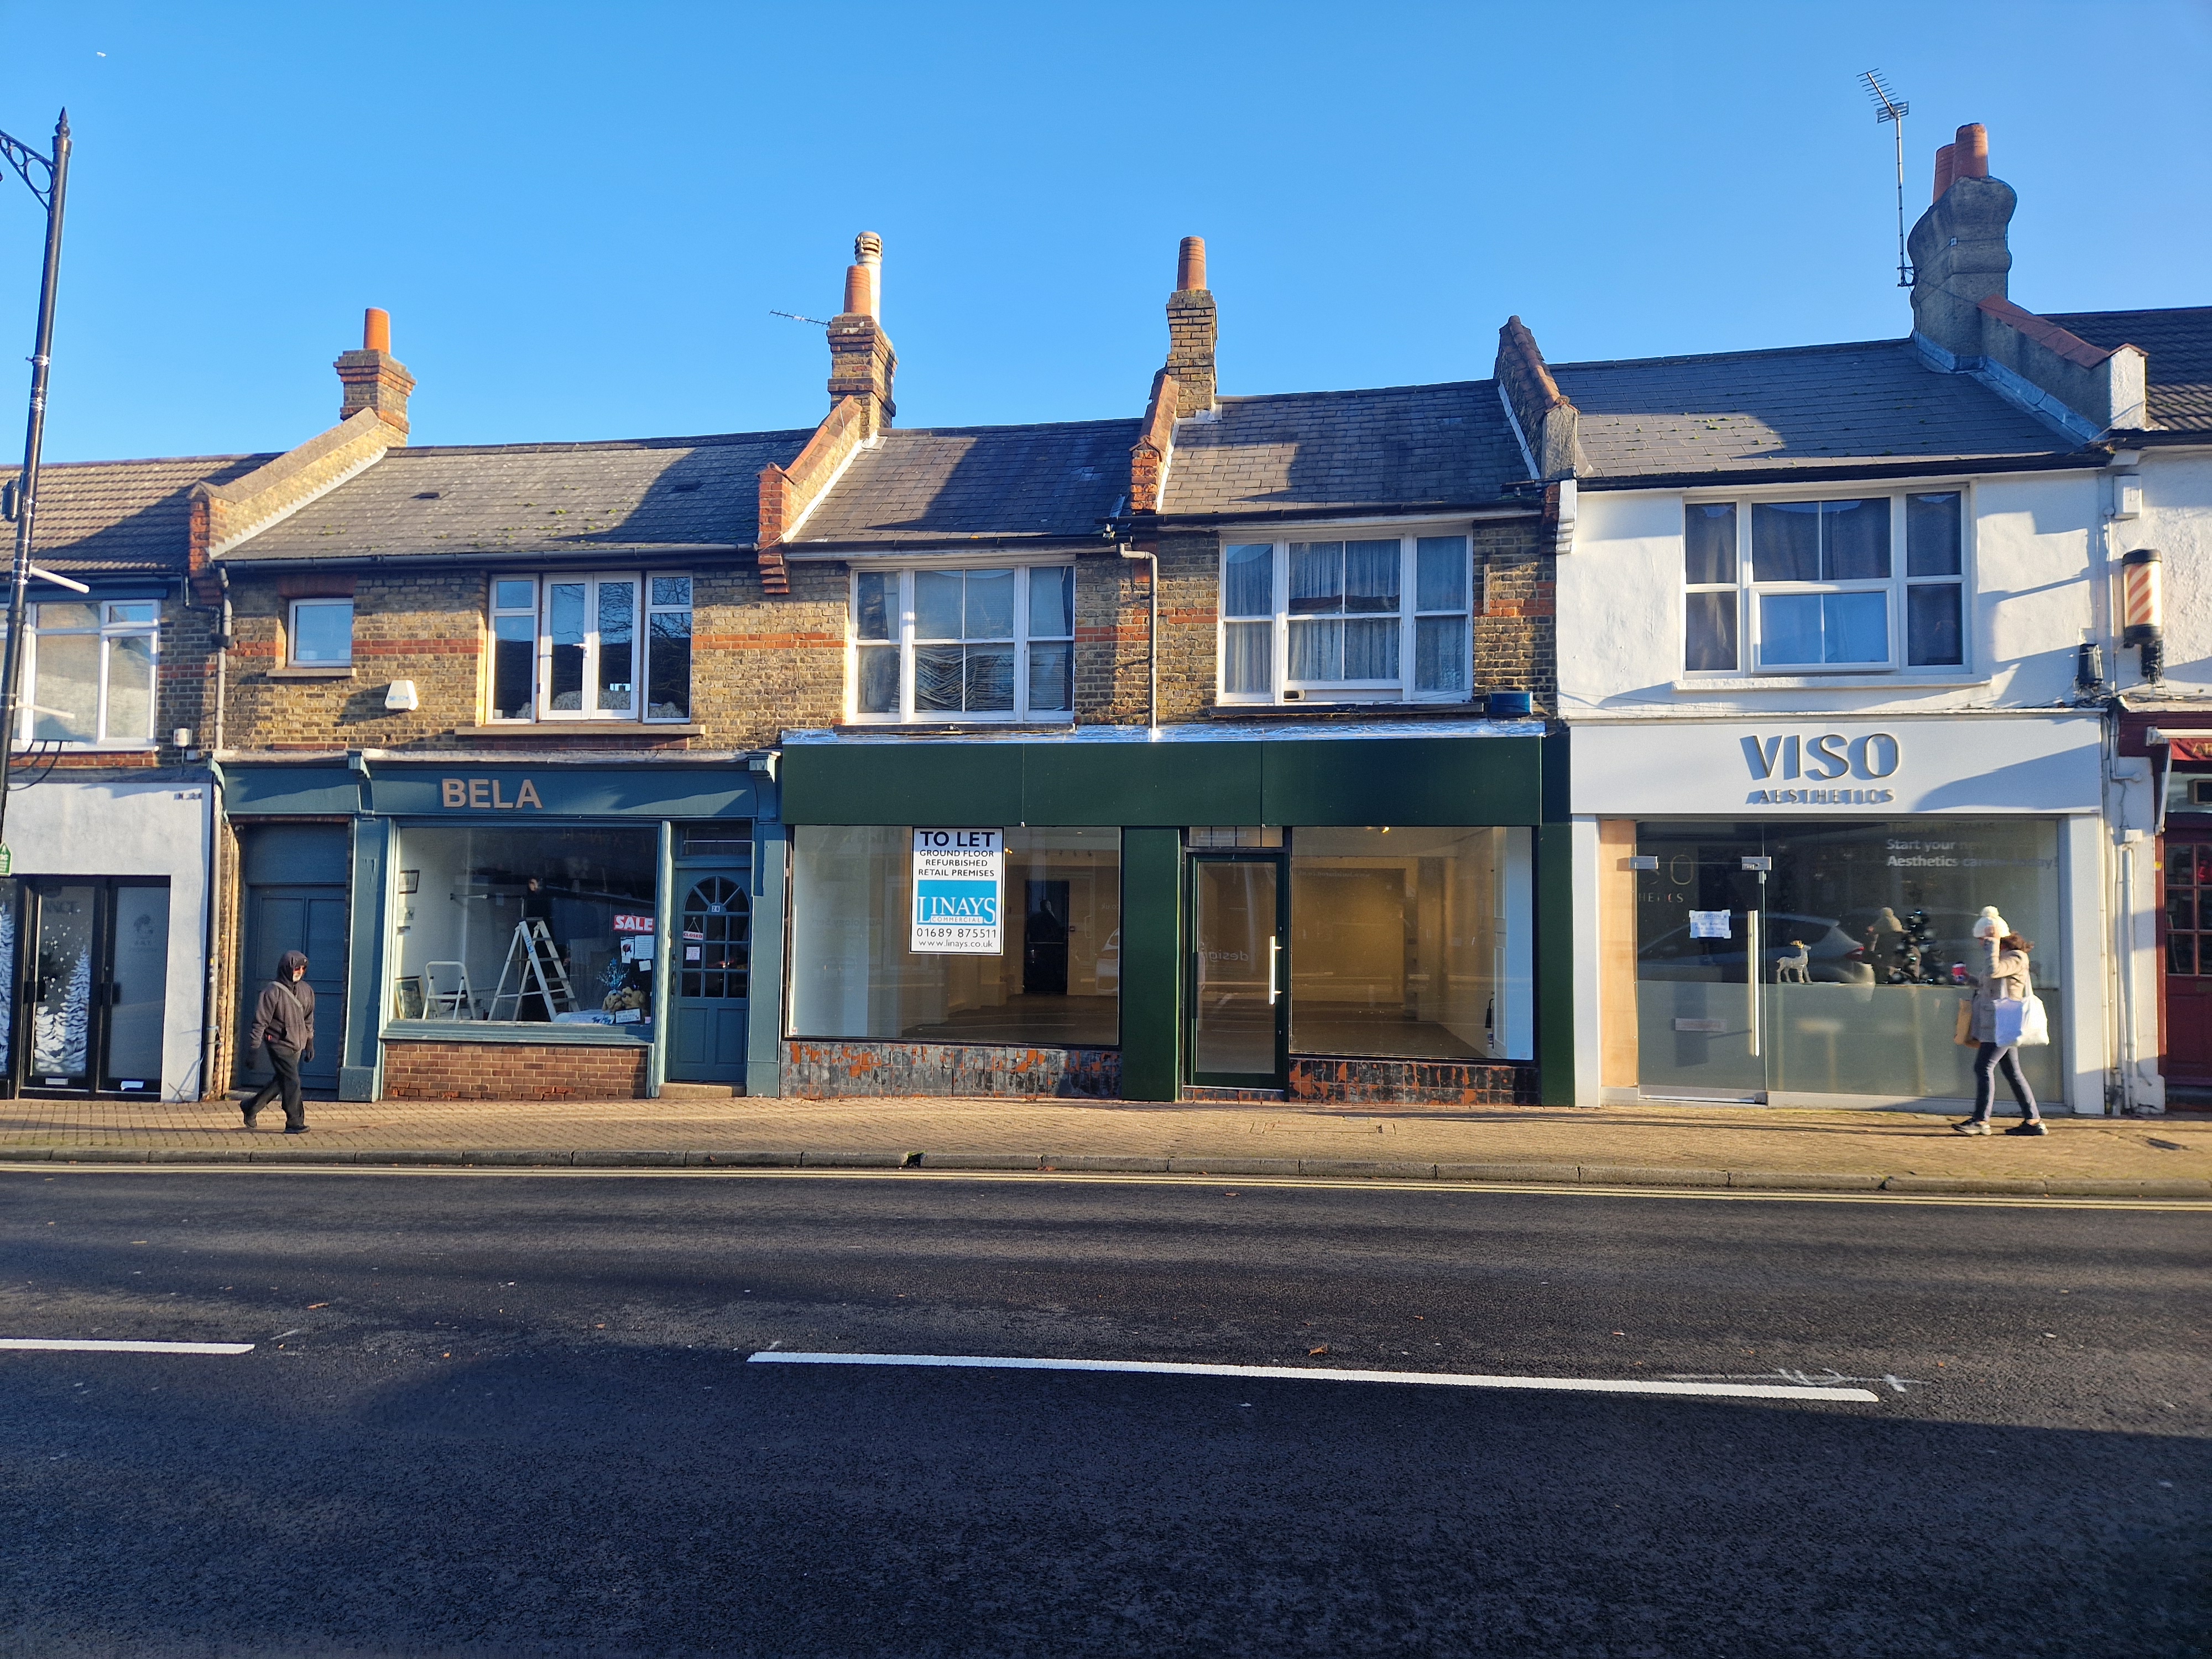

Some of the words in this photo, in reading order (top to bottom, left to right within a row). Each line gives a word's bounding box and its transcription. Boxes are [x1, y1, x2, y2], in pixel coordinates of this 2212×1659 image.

[1742, 733, 1899, 780] VISO
[442, 778, 542, 808] BELA
[1747, 789, 1895, 804] AESTHETICS
[920, 831, 950, 847] TO
[957, 831, 995, 847] LET
[1886, 839, 1921, 850] Start
[1926, 841, 1955, 852] your
[1886, 855, 1959, 867] Aesthetics
[918, 896, 996, 924] LINAYS
[615, 916, 653, 931] SALE
[917, 927, 952, 937] 01689
[957, 928, 996, 938] 875511
[919, 939, 993, 949] www.linays.co.uk
